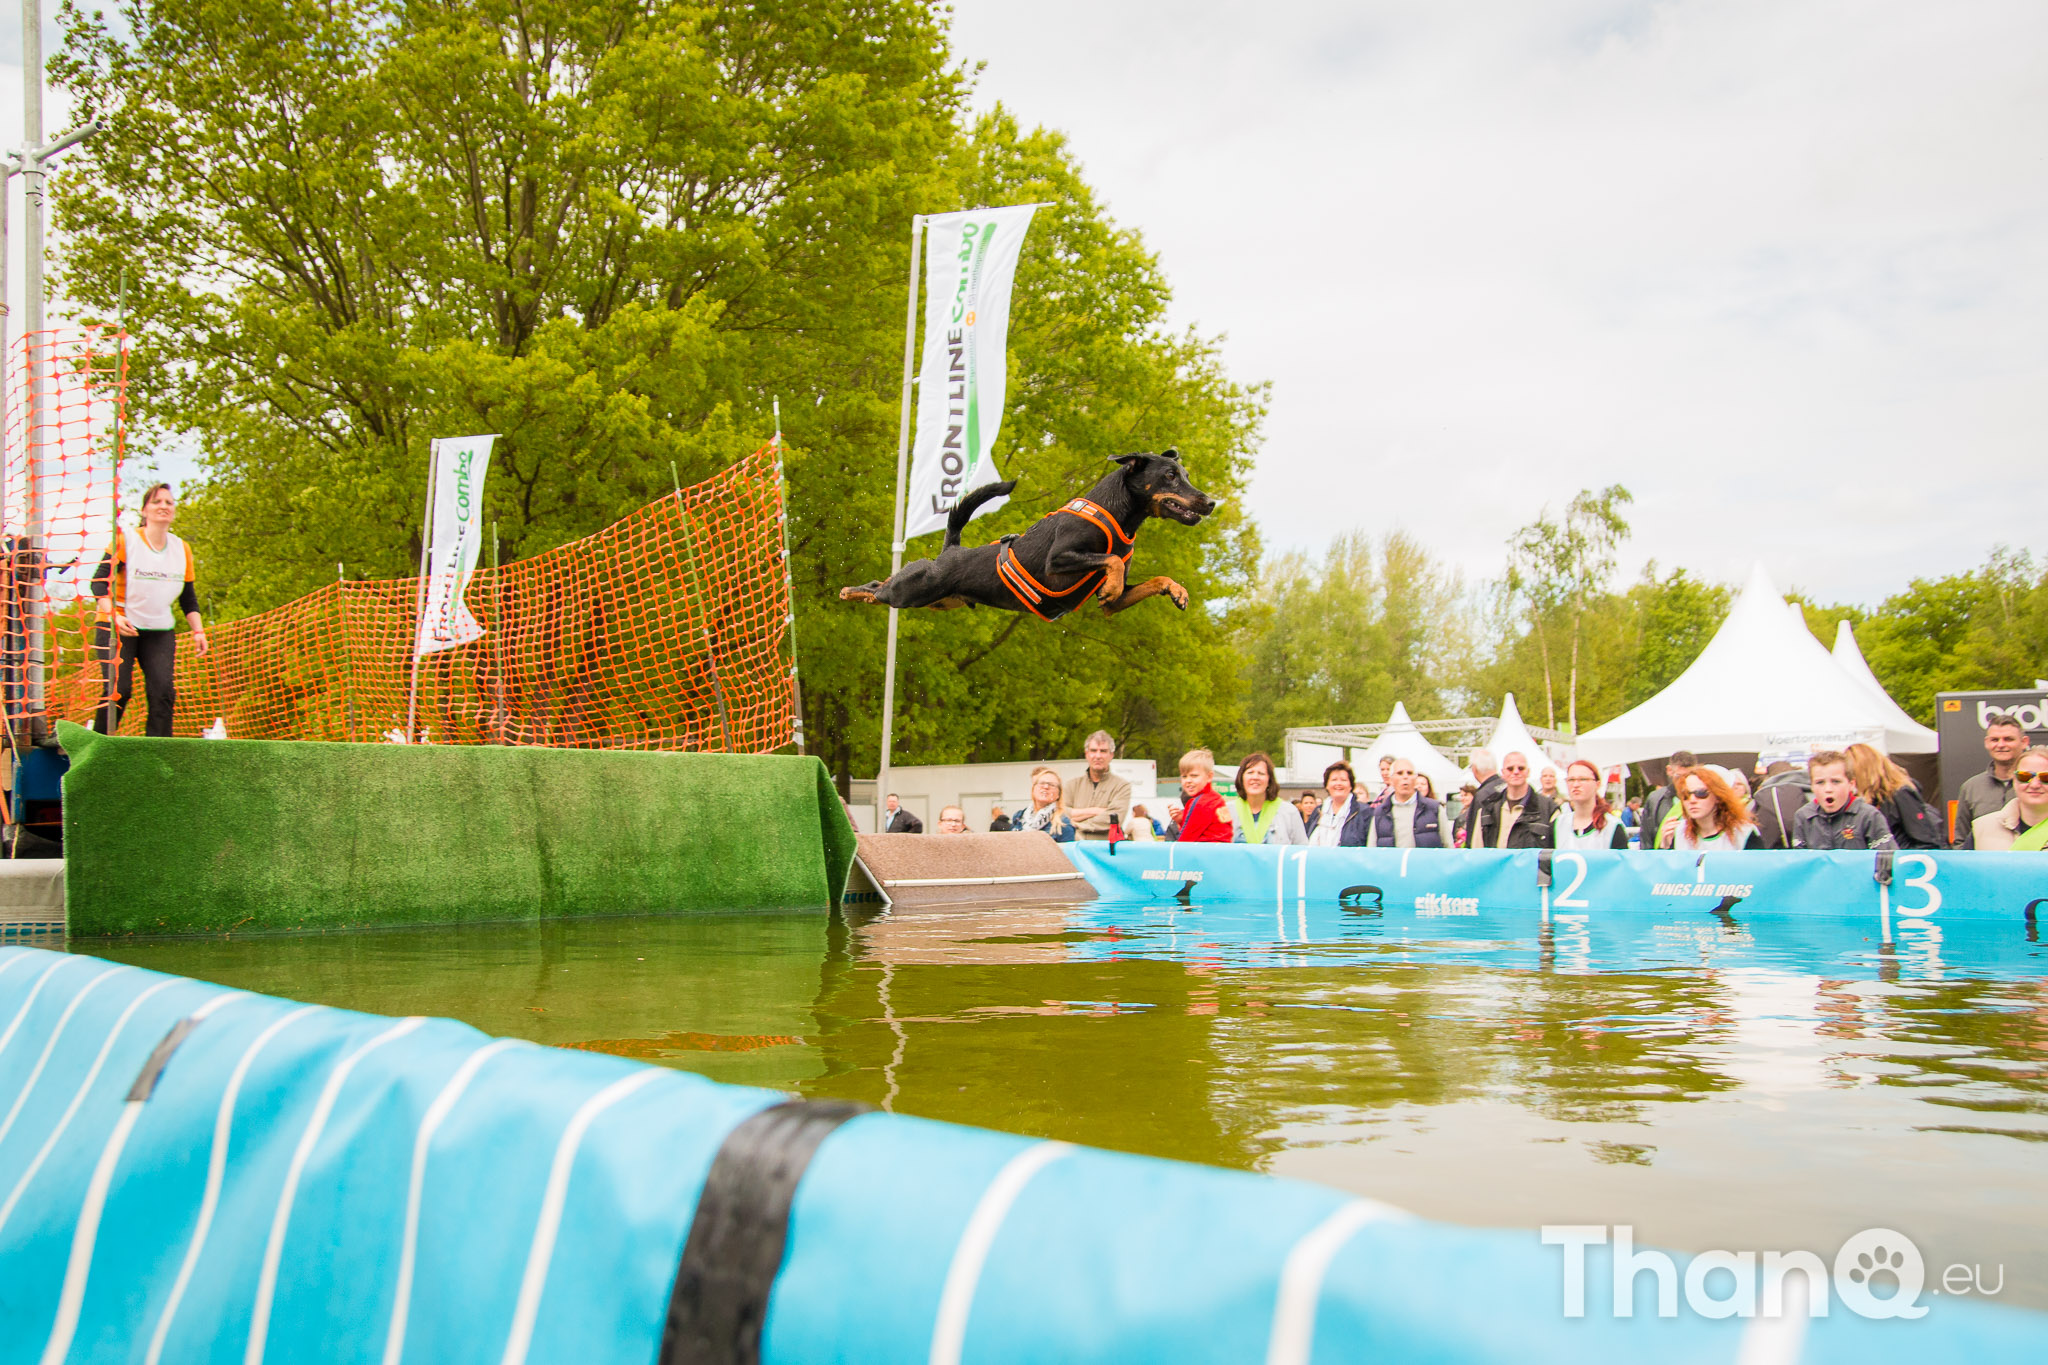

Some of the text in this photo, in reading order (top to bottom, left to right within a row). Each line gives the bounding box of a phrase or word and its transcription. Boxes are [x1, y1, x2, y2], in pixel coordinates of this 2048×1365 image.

[1553, 852, 1589, 907] 2
[1651, 883, 1754, 898] KINGS AIR DOGS
[1896, 854, 1942, 917] 3
